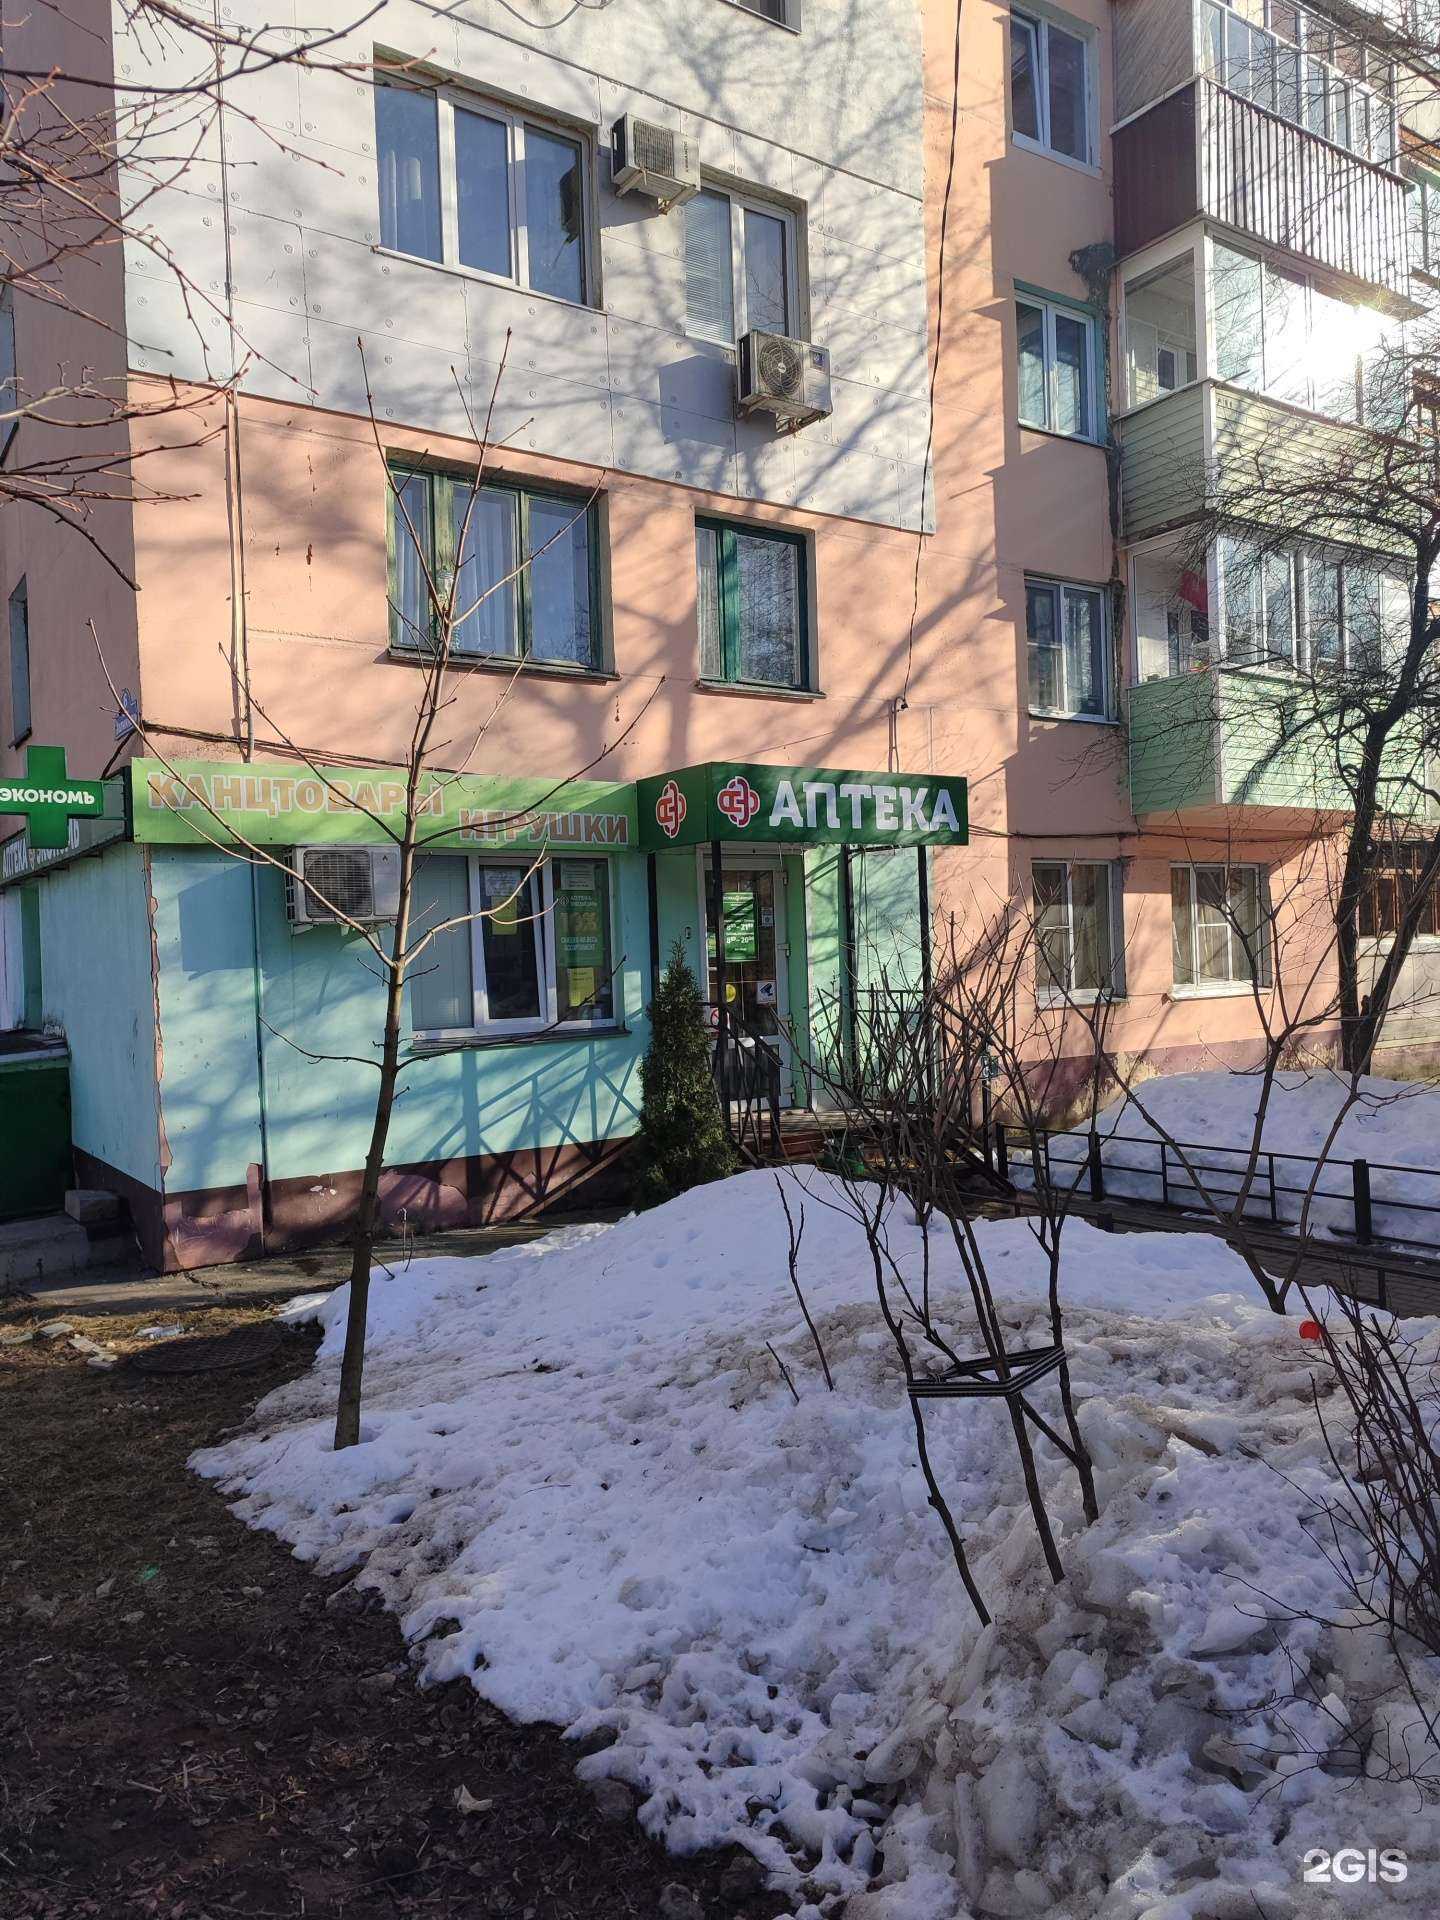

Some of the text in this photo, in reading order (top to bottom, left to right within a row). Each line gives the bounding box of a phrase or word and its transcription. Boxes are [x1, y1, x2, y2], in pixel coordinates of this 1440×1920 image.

[0, 788, 95, 805] ЭКОНОМЬ
[148, 772, 445, 818] КАНЦТОВАРЫ
[769, 780, 960, 832] АПТЕКА
[459, 808, 629, 845] ИГРУШКИ
